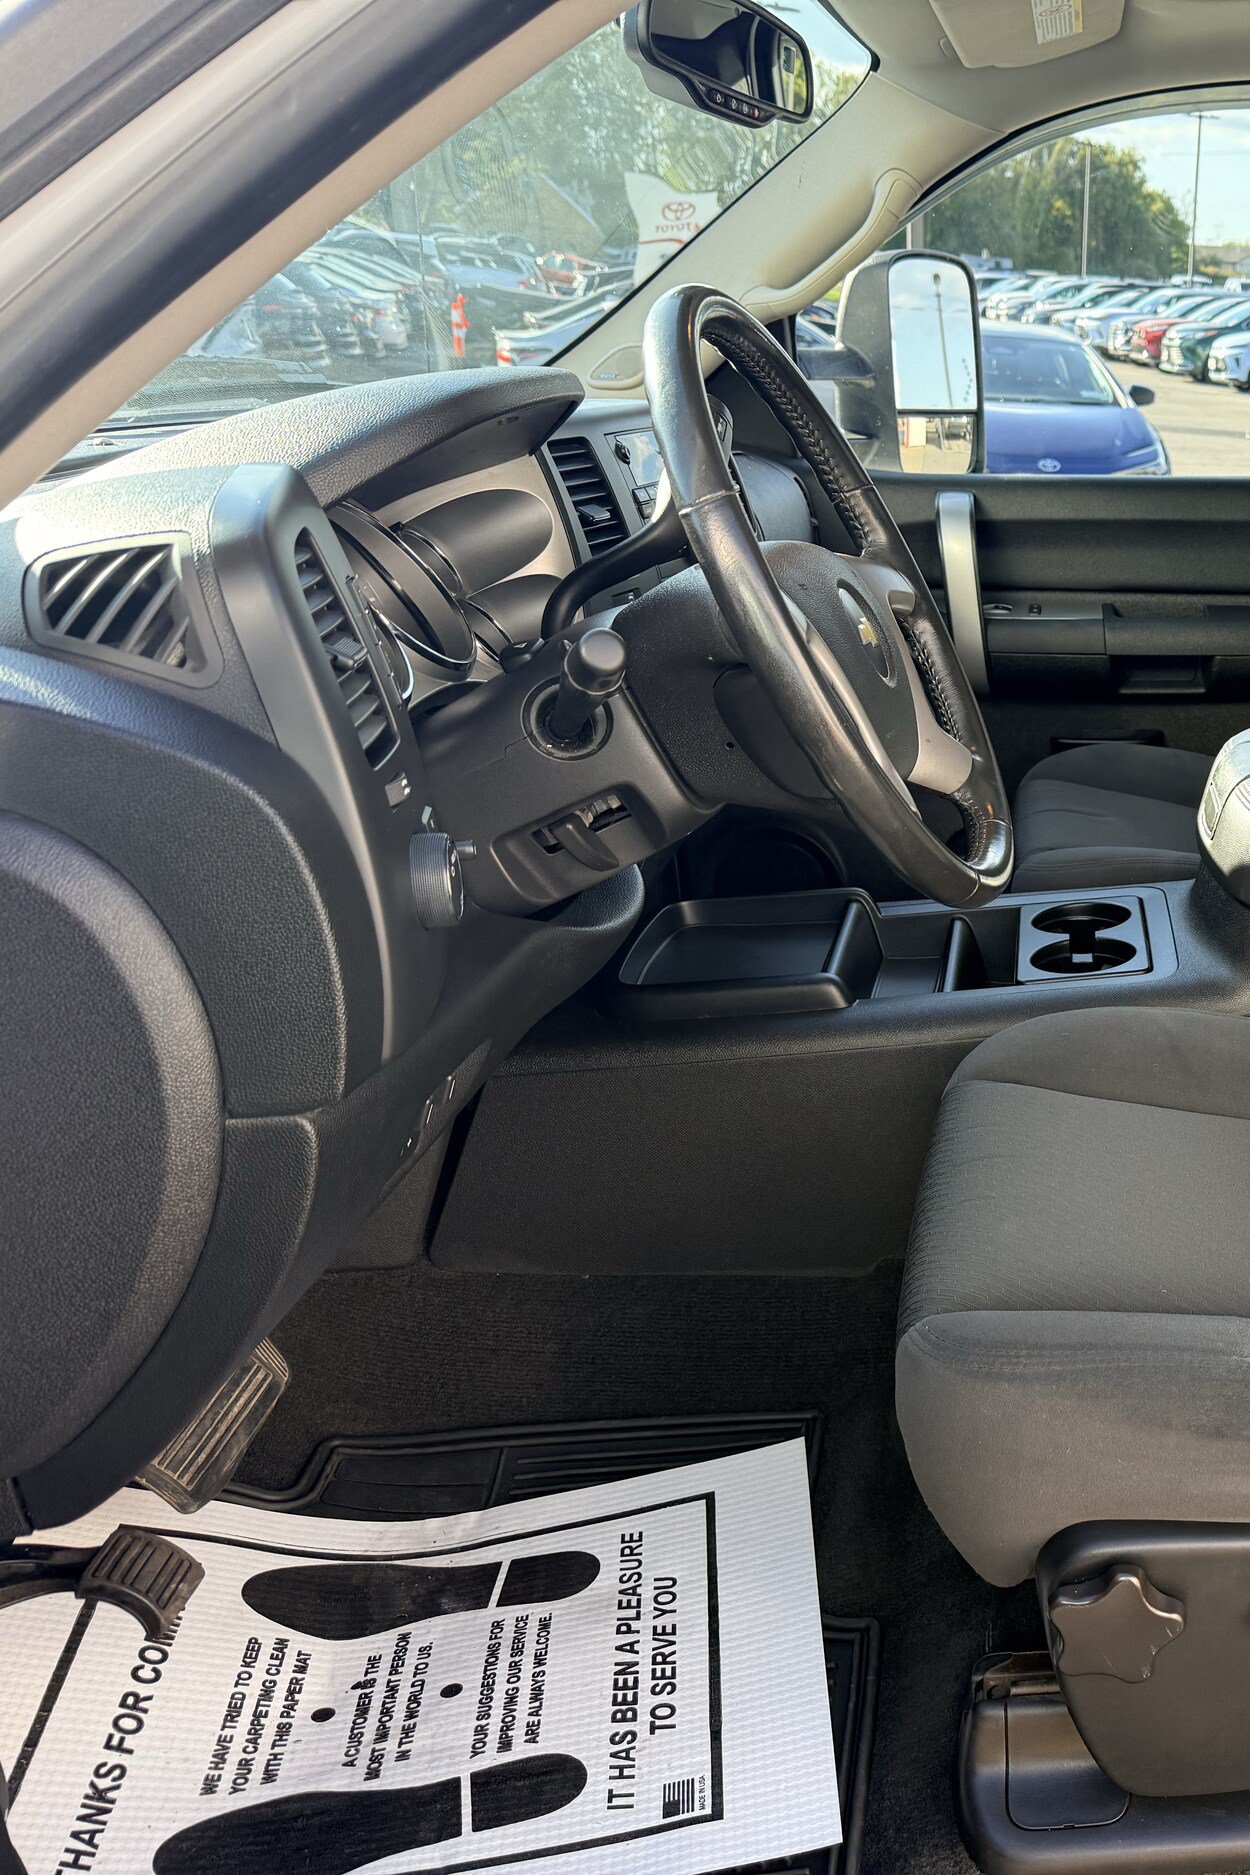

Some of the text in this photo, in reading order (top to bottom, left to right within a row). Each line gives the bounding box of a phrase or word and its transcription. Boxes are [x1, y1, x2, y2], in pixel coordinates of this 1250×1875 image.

[199, 1637, 262, 1796] WE HAVE TRIED TO KEEP
[228, 1638, 290, 1795] YOUR CARPETING CLEAN
[260, 1650, 311, 1785] WITH THIS PAPER MAT
[345, 1691, 374, 1757] CUSTOMER
[364, 1654, 382, 1677] THE
[364, 1632, 412, 1781] MOST IMPORTANT PERSON
[395, 1642, 433, 1762] IN THE WORLD TO US.
[470, 1619, 505, 1759] YOUR SUGGESTIONS FOR
[496, 1614, 529, 1753] IMPROVING OUR SERVICE
[524, 1613, 552, 1743] ARE ALWAYS WELCOME.
[607, 1531, 643, 1810] IT HAS BEEN A PLEASURE
[649, 1577, 677, 1735] TO SERVE YOU
[55, 1762, 127, 1875] HANKS
[104, 1691, 154, 1755] FOR
[342, 1758, 358, 1767] A
[698, 1774, 706, 1811] MADE IN USA
